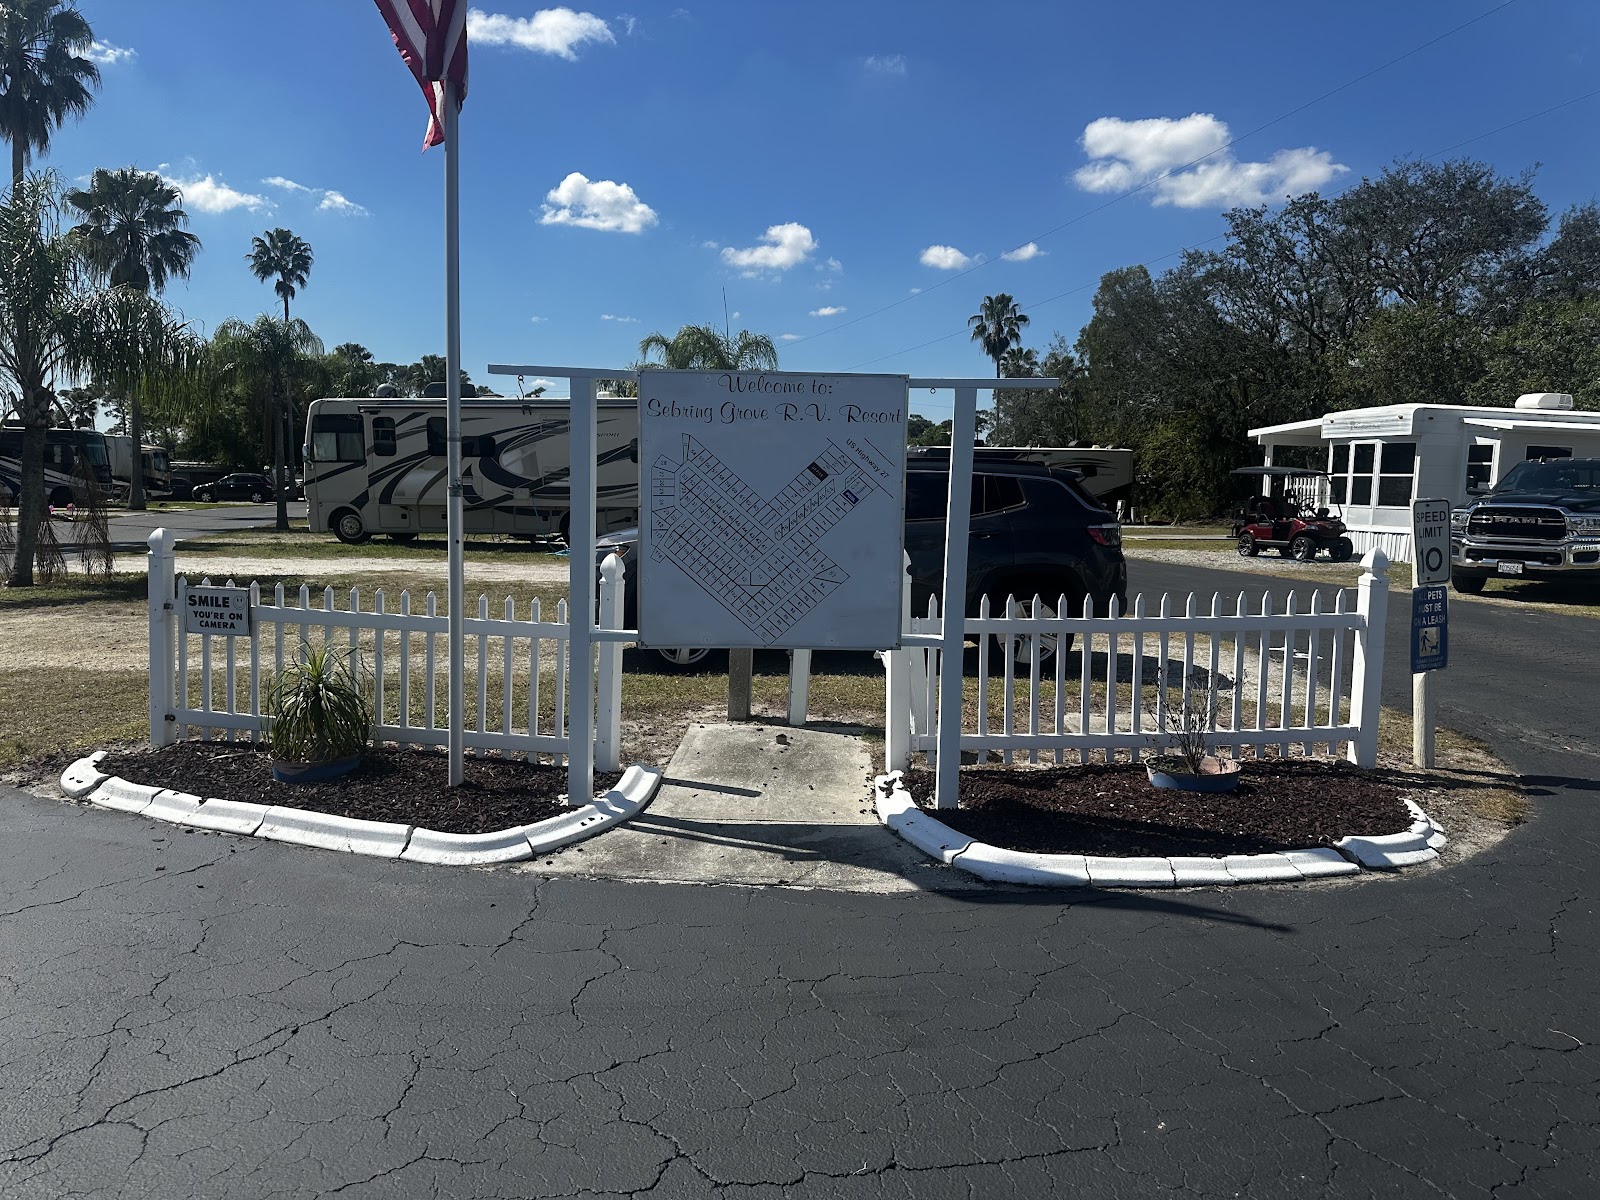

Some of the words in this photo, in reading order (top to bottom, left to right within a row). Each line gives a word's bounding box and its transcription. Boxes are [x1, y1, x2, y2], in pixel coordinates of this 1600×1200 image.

[718, 374, 805, 394] Welcome
[812, 380, 832, 394] to:
[647, 398, 713, 423] Sebring
[720, 402, 768, 424] Grove
[838, 404, 902, 423] Resort
[846, 438, 856, 448] US
[855, 447, 881, 472] Highway
[880, 470, 889, 478] 27
[1416, 511, 1446, 523] SPEED
[1419, 526, 1443, 538] LIMIT
[1420, 547, 1443, 573] 10
[1428, 590, 1442, 600] PETS
[188, 595, 229, 608] SMILE
[1434, 602, 1442, 612] BE
[193, 611, 224, 619] YOU'RE
[1422, 617, 1426, 625] A
[1428, 614, 1445, 625] LEASH
[200, 620, 235, 629] CAMERA
